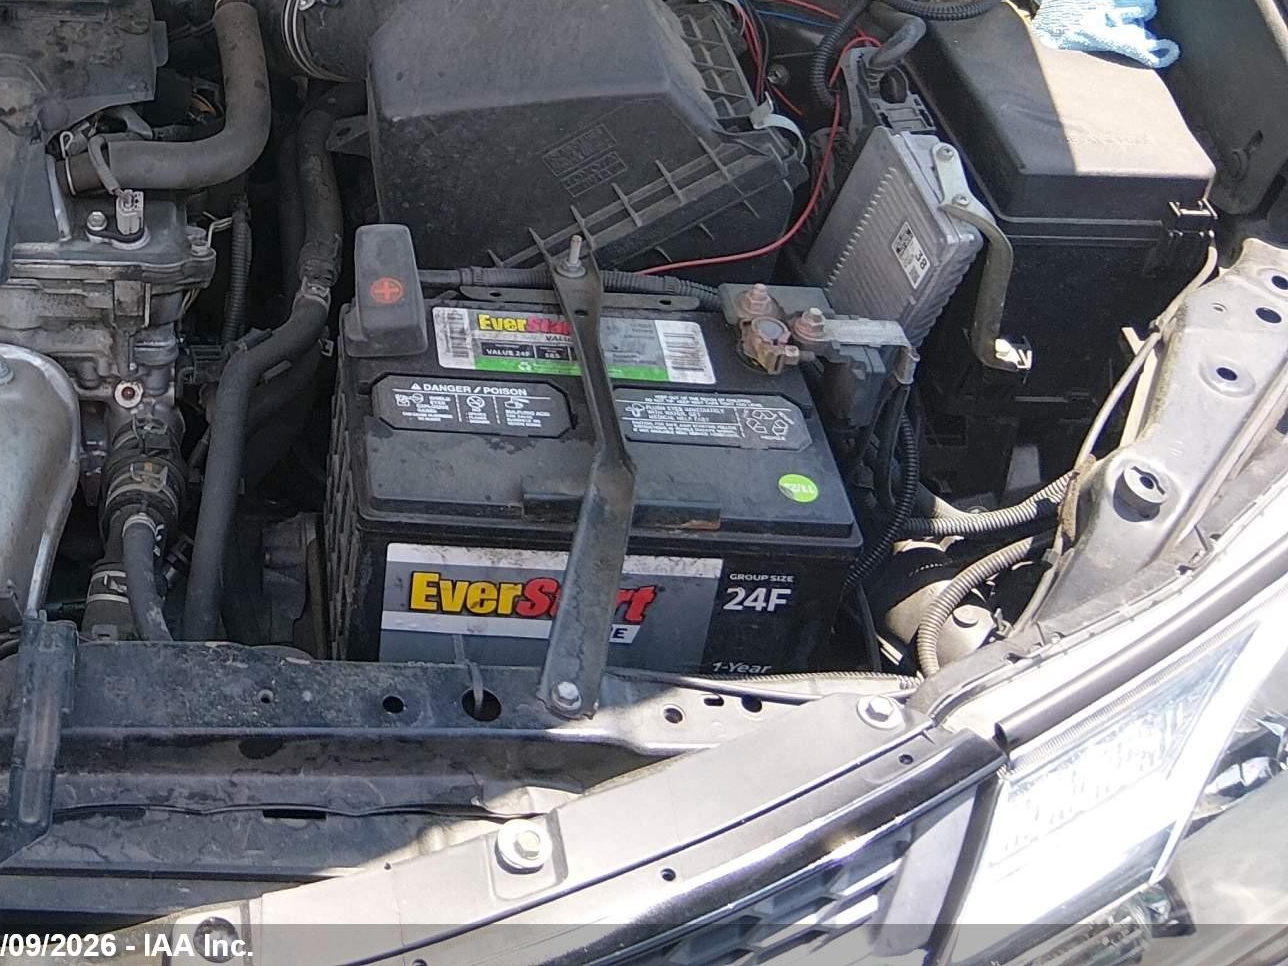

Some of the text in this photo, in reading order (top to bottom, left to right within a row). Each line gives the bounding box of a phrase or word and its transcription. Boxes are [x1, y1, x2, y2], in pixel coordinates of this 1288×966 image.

[915, 249, 928, 270] 38
[478, 313, 570, 335] EverSta
[423, 383, 472, 393] DANGER
[483, 386, 527, 396] POISON
[729, 573, 769, 582] GROUP
[723, 587, 791, 611] 24F
[712, 661, 772, 674] 1-Year
